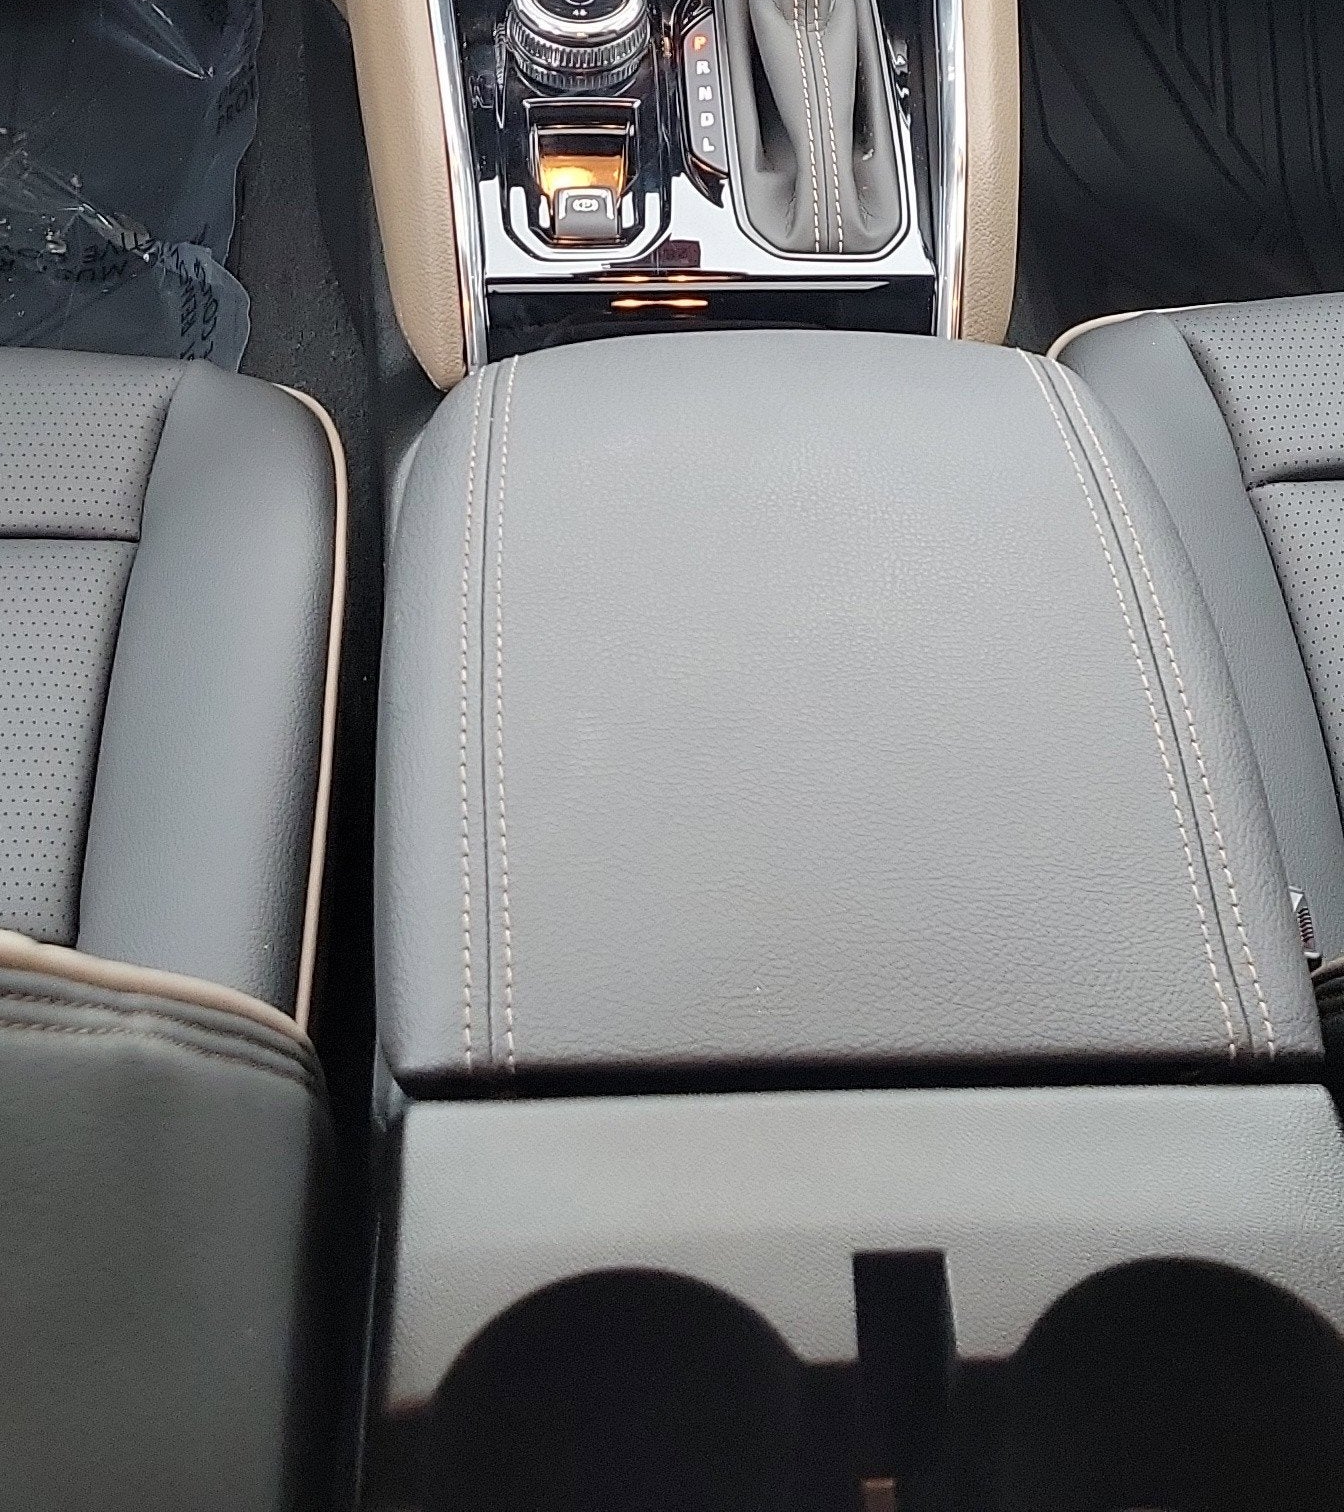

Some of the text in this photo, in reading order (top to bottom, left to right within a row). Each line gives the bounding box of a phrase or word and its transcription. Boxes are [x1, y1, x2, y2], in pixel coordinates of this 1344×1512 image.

[694, 36, 715, 152] P R N D L
